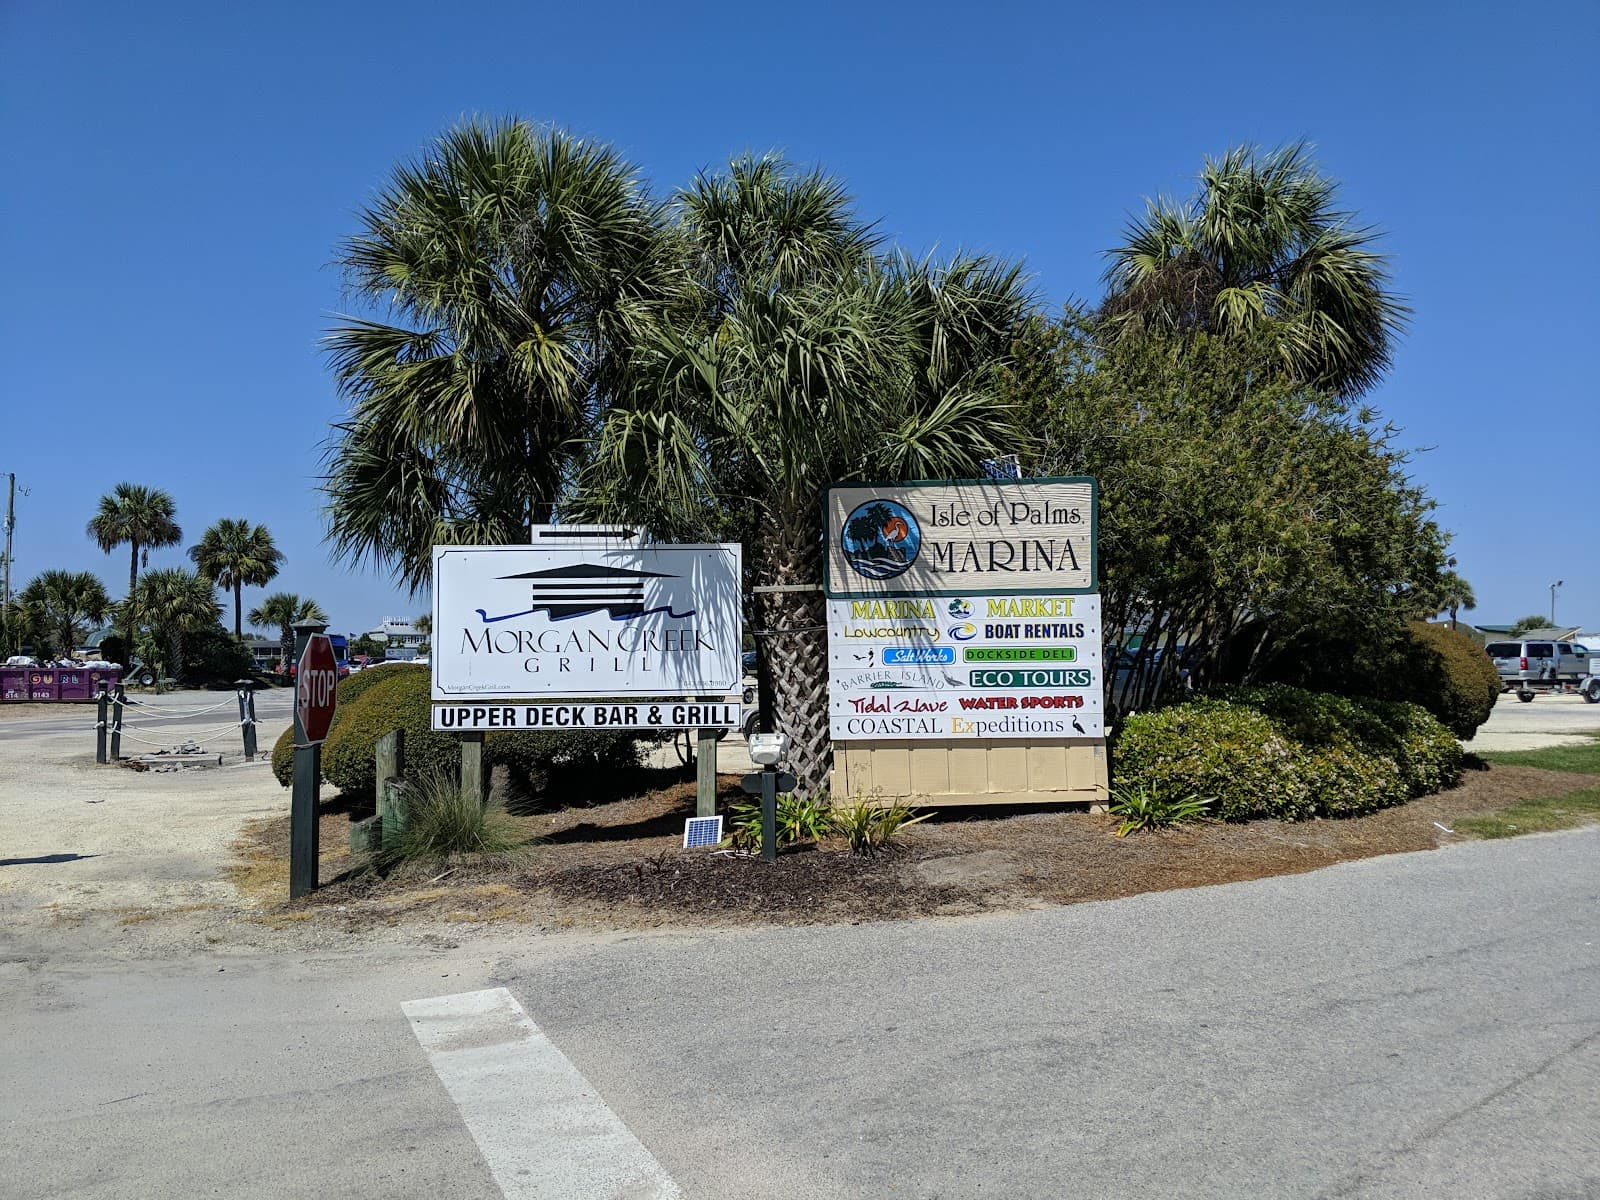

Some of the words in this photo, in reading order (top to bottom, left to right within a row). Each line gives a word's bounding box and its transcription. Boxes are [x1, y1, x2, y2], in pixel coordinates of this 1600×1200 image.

[930, 503, 971, 527] Isle
[977, 501, 1000, 526] of
[1010, 500, 1081, 525] Palms
[930, 538, 1081, 572] MARINA
[851, 599, 936, 620] MARINA
[986, 597, 1075, 618] MARKET
[461, 627, 609, 654] MORGAN
[617, 627, 716, 653] CREEK
[844, 624, 940, 642] Lowcountry
[985, 624, 1021, 639] BOAT
[1024, 623, 1084, 639] RENTALS
[891, 648, 915, 663] Salt
[916, 648, 948, 662] Works
[966, 650, 1038, 659] DOCKSIDE
[1042, 648, 1073, 659] DELI
[524, 657, 652, 673] GRILL
[301, 669, 335, 709] STOP
[841, 670, 891, 691] BARRIER
[901, 671, 945, 690] ISLAND
[971, 671, 1014, 686] ECO
[1020, 671, 1089, 686] TOURS
[848, 695, 892, 713] Tidal
[894, 698, 948, 712] Wave
[959, 697, 1019, 711] WATER
[1020, 696, 1084, 709] SPORTS
[441, 707, 516, 727] UPPER
[526, 706, 586, 726] DECK
[594, 706, 638, 725] BAR
[647, 706, 663, 725] &
[672, 706, 735, 725] GRILL
[847, 717, 943, 734] COASTAL
[951, 715, 1064, 738] Expeditions
